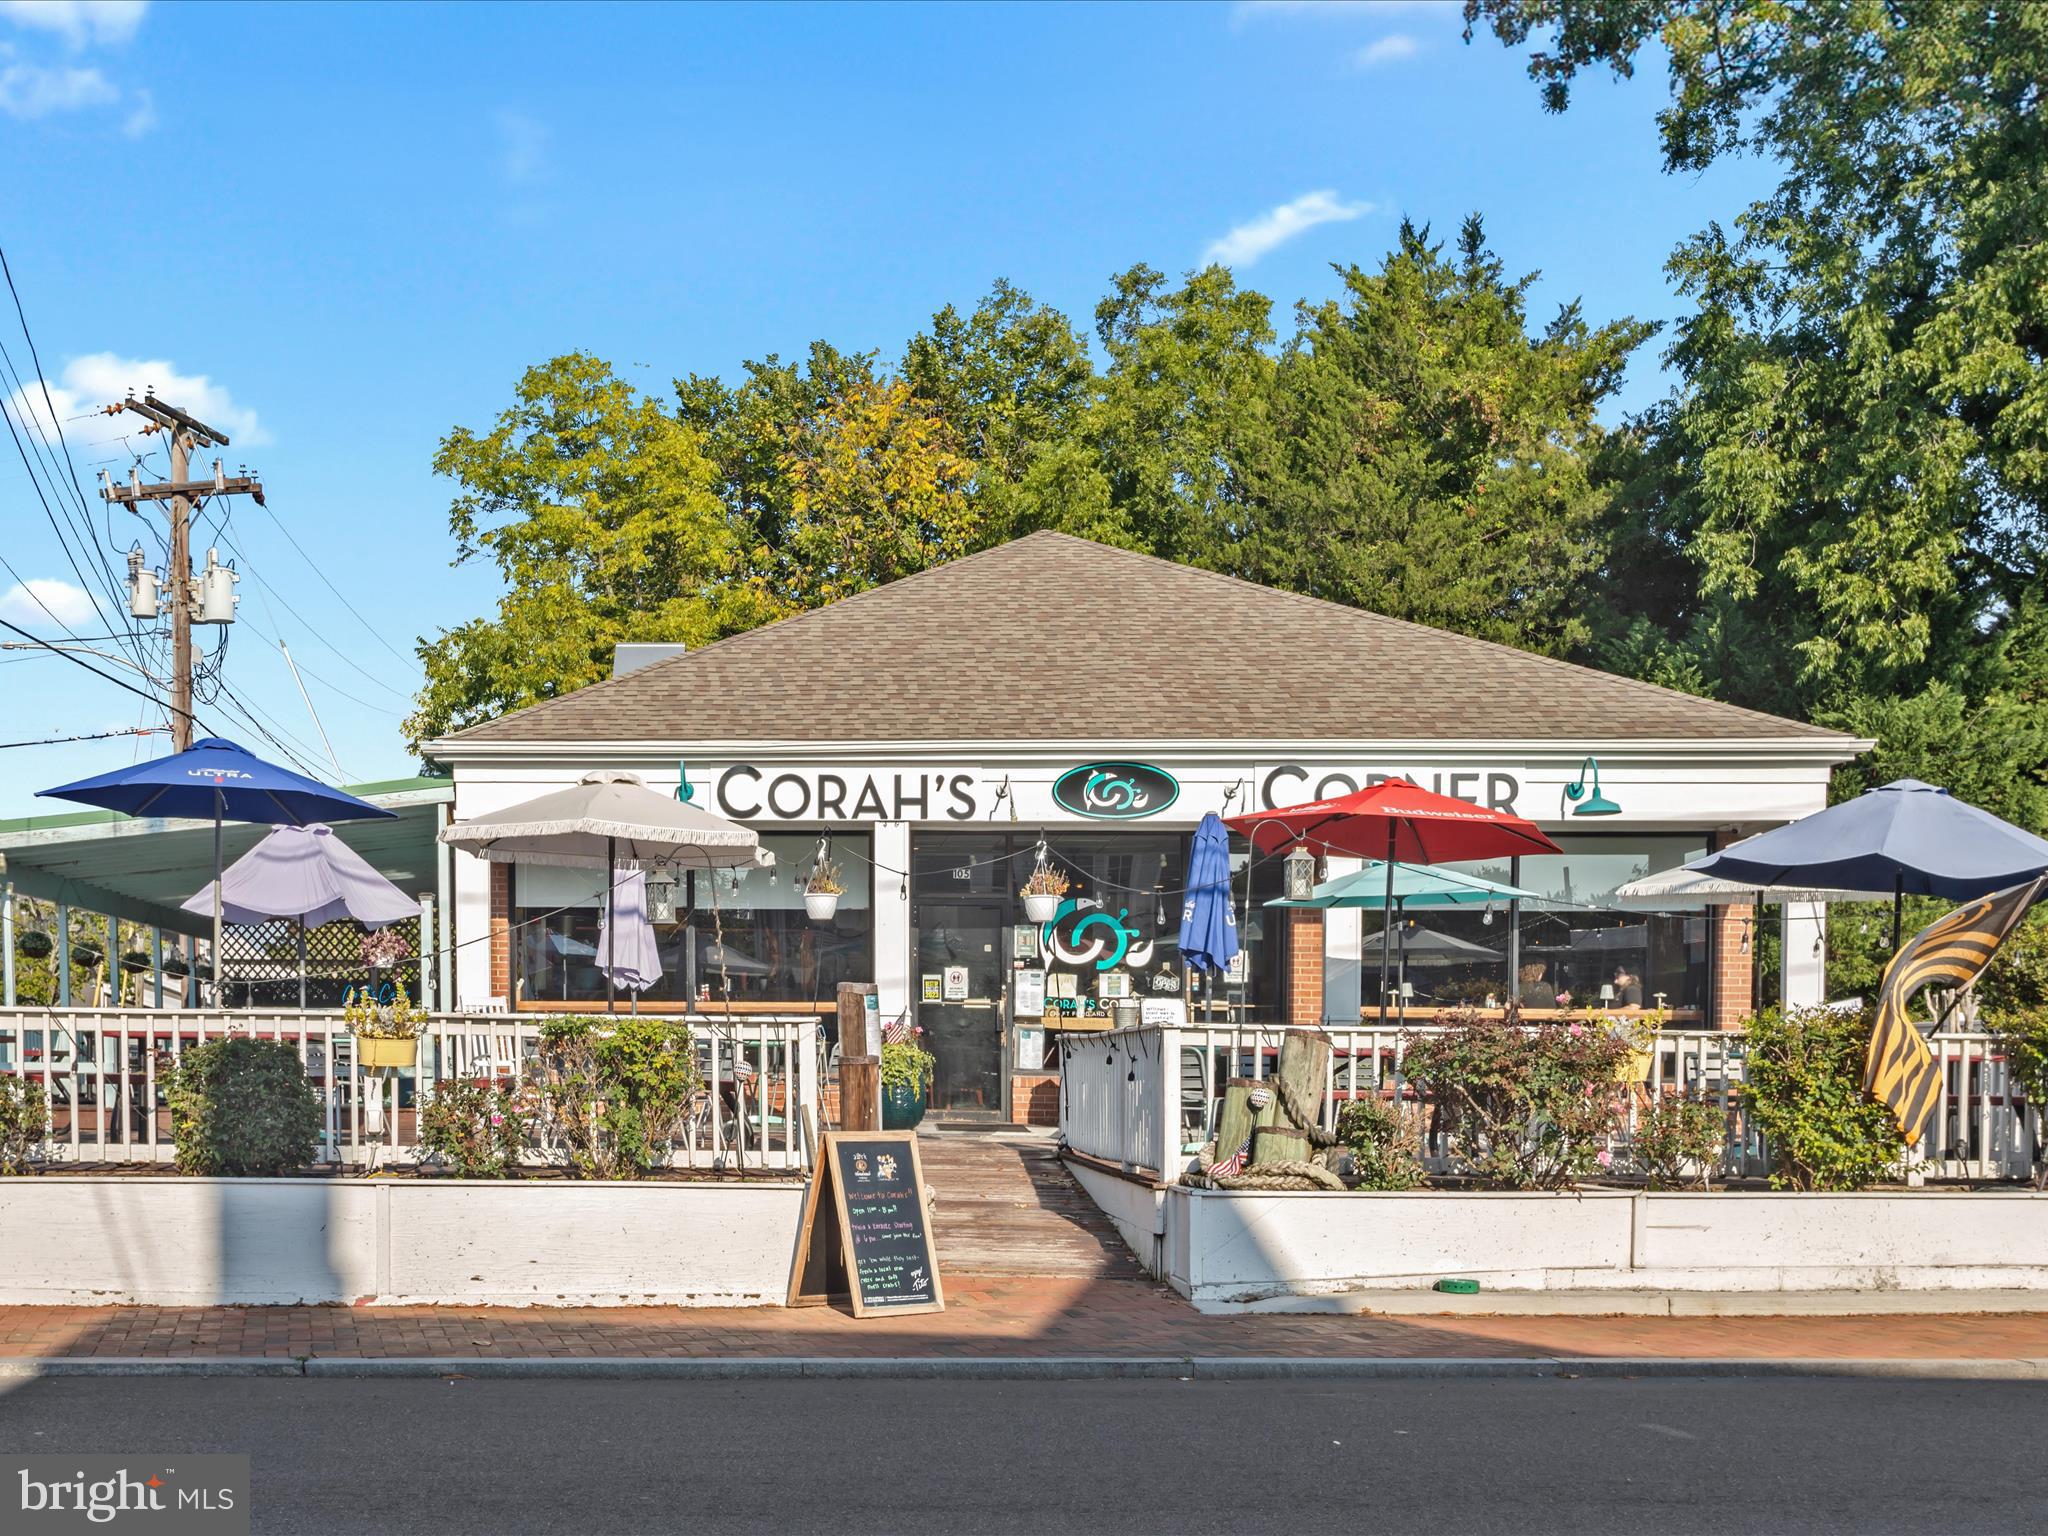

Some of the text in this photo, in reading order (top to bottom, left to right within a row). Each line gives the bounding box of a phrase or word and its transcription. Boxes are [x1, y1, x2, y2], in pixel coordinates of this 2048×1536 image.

[187, 768, 254, 779] ULTRA
[717, 765, 977, 820] CORAH'S
[1381, 806, 1497, 820] Budweiser
[953, 868, 969, 879] 105
[1155, 977, 1177, 991] OPEN
